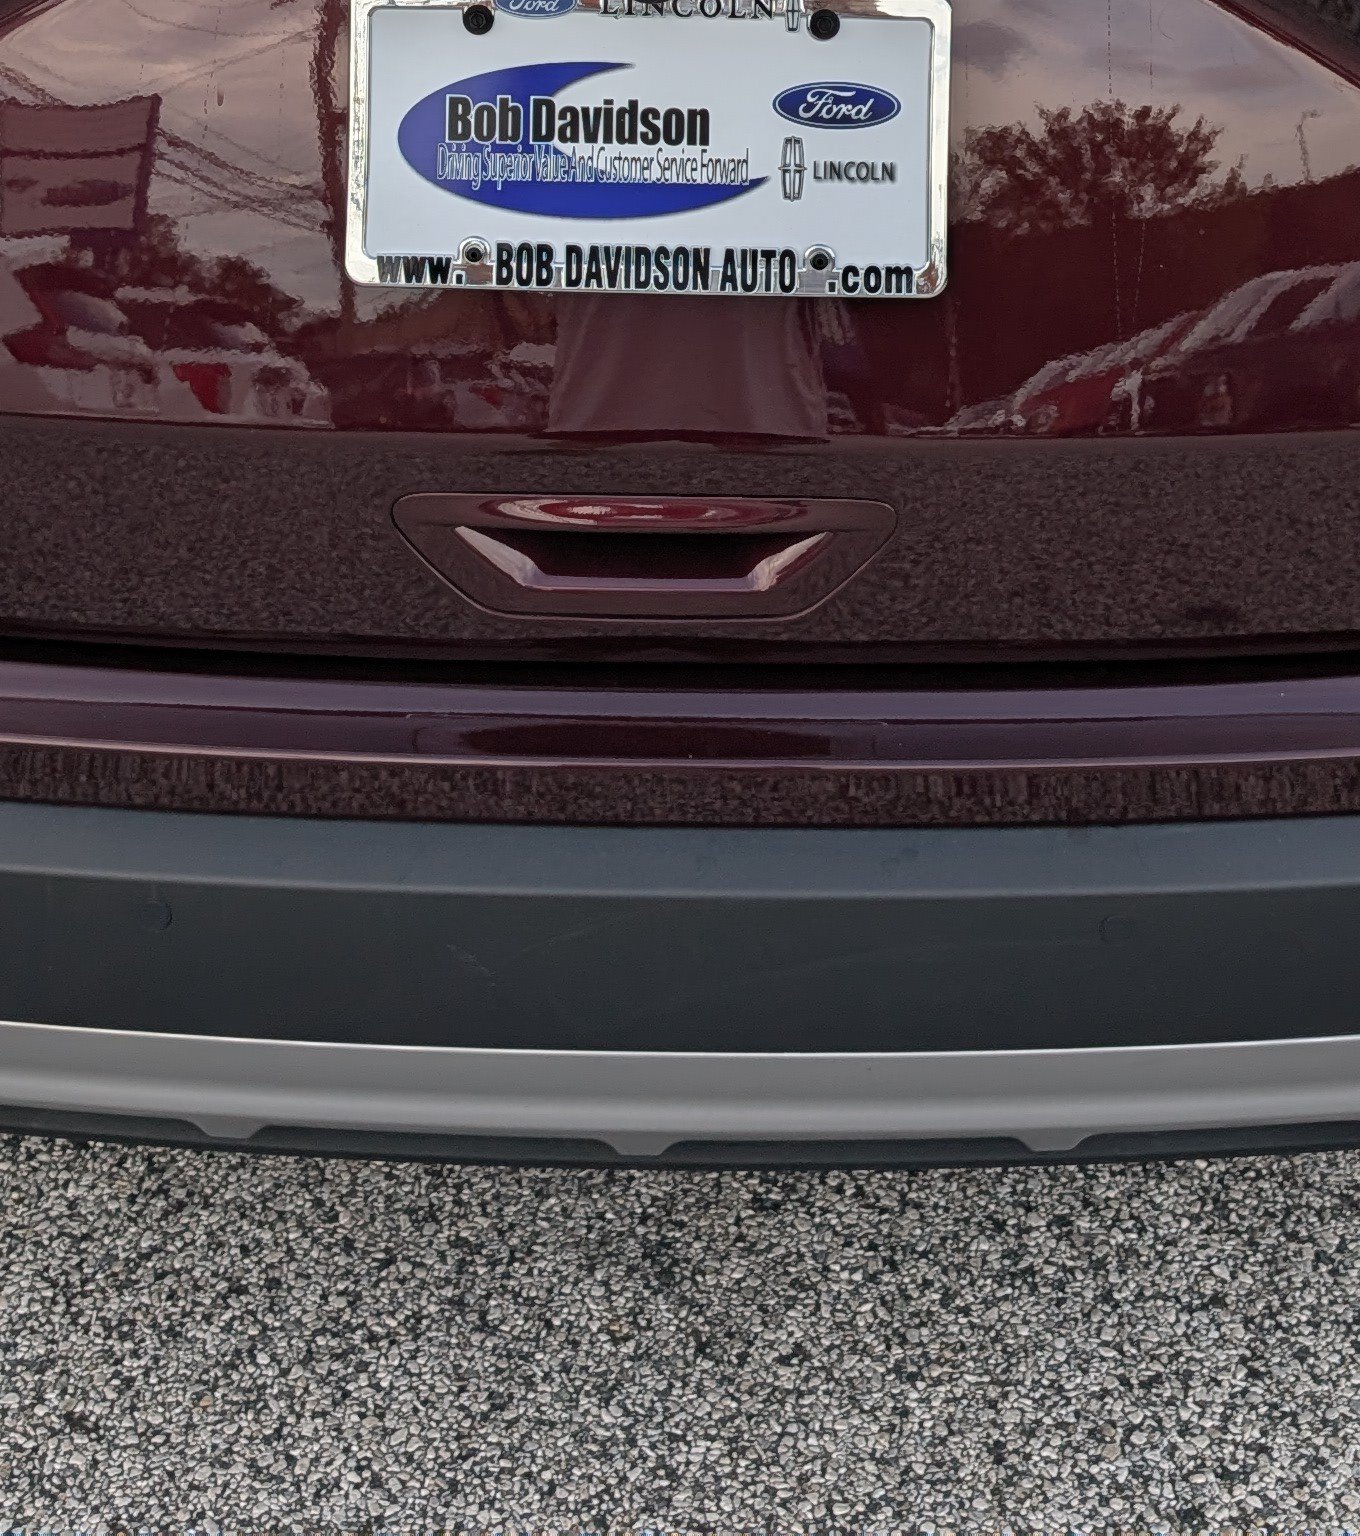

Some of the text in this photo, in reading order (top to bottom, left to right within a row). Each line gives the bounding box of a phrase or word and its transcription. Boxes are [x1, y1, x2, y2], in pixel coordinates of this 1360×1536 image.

[446, 94, 711, 148] Bob Davidson
[798, 88, 874, 120] Ford
[437, 142, 750, 191] Driving Superior Value And Customer Service Forward
[813, 159, 896, 182] LINCOLN
[377, 241, 913, 297] www. BOB DAVIDSON AUTO .com
